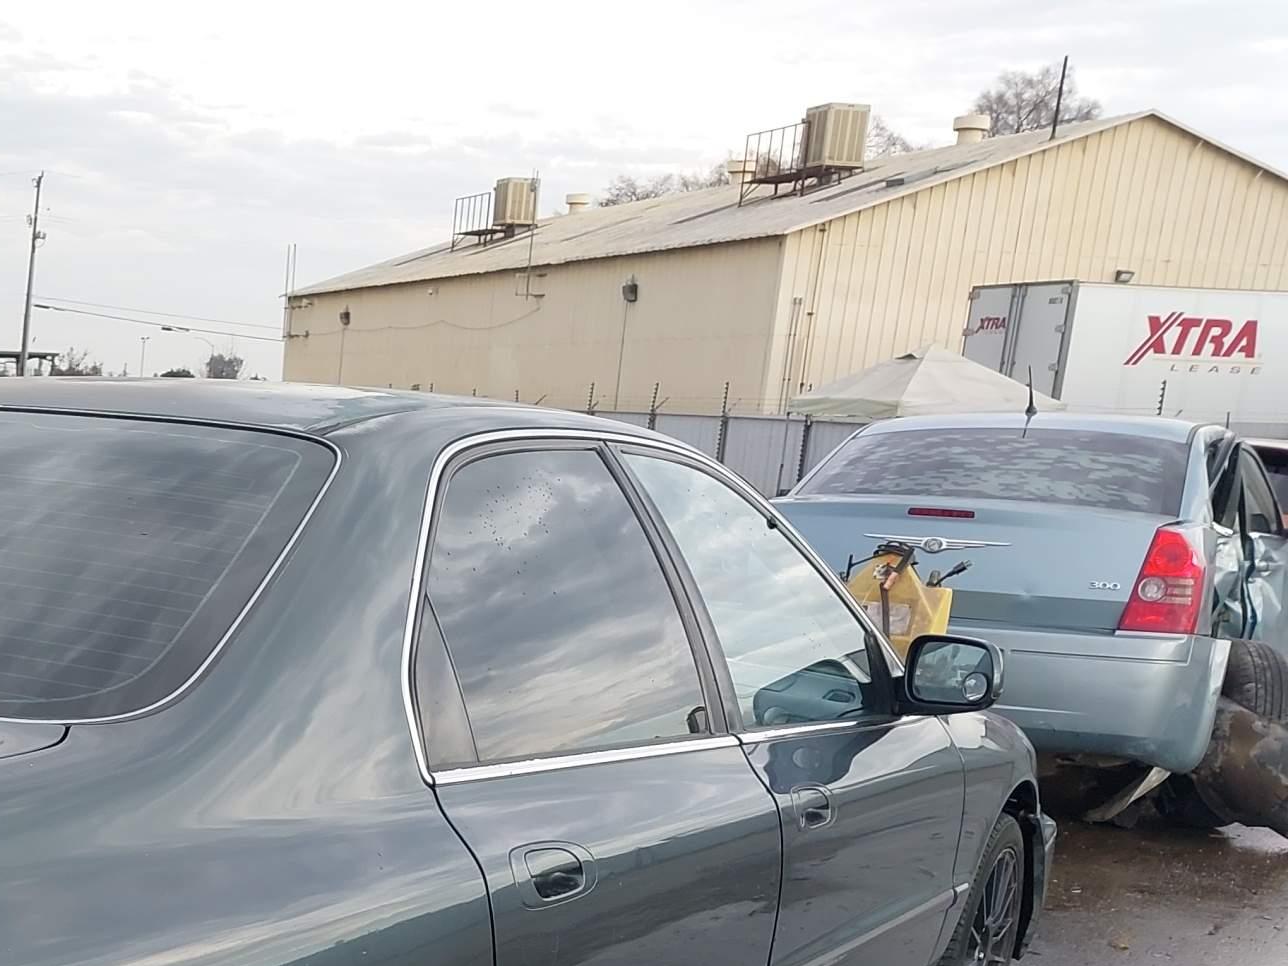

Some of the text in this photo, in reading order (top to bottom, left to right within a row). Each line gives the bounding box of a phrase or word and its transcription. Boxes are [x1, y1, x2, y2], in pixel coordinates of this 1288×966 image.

[975, 317, 1007, 333] XTRA
[1123, 312, 1258, 368] XTRA
[1169, 363, 1262, 375] LEASE
[1088, 580, 1121, 590] 300
